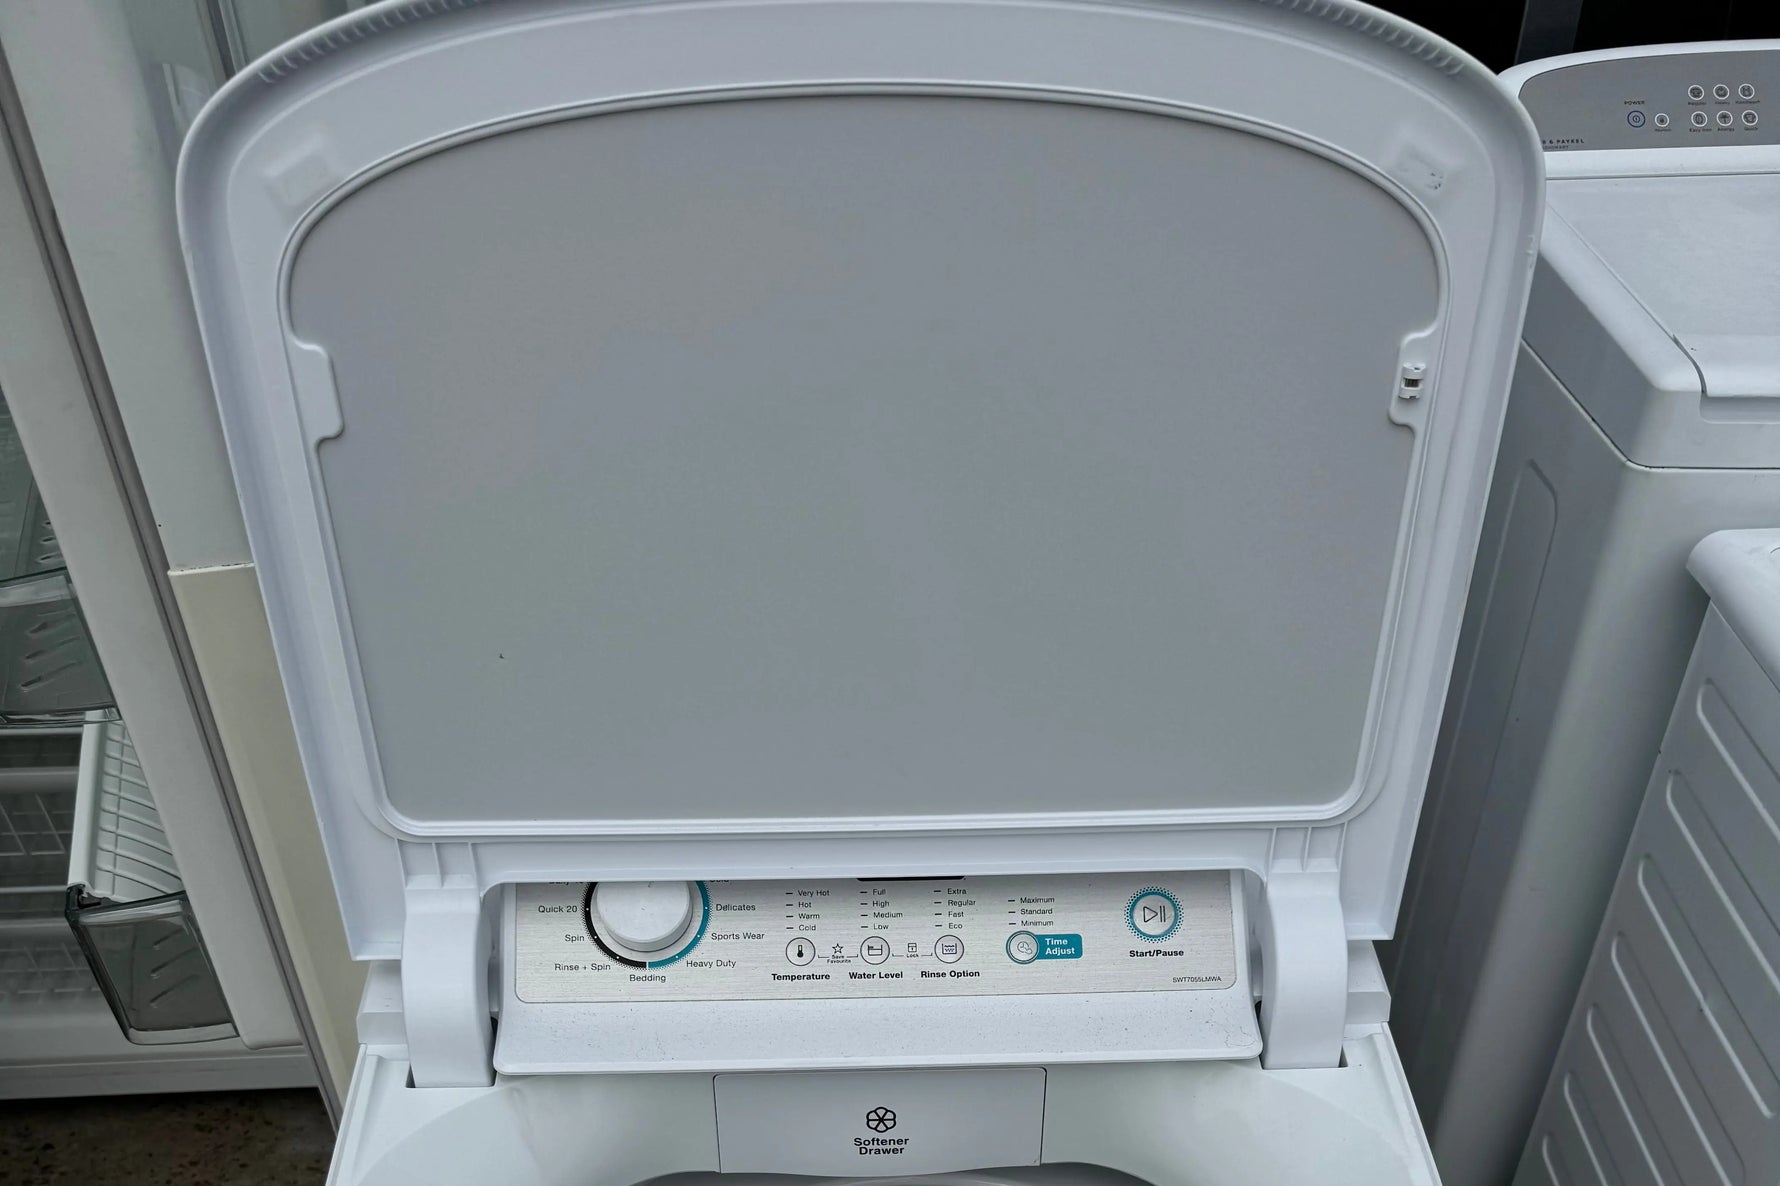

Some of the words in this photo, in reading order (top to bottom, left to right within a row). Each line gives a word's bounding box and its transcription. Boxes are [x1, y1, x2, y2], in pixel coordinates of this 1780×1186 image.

[798, 890, 814, 898] Very
[816, 889, 830, 897] Hot
[872, 900, 890, 908] High
[948, 899, 976, 908] Regular
[1020, 896, 1055, 904] Maximum
[538, 905, 564, 914] Quick
[566, 905, 578, 913] 20
[716, 903, 756, 911] Delicates
[873, 911, 903, 919] Medium
[1020, 908, 1053, 916] Standard
[1021, 919, 1054, 927] Minimum
[564, 934, 584, 944] Spin
[712, 932, 740, 942] Sports
[743, 932, 765, 940] Wear
[1045, 938, 1068, 946] Time
[1045, 946, 1075, 956] Adjust
[1129, 949, 1184, 958] Start/Pause
[554, 963, 580, 972] Rinse
[590, 963, 610, 972] Spin
[686, 960, 714, 970] Heavy
[717, 960, 737, 969] Duty
[630, 974, 666, 983] Bedding
[772, 973, 830, 982] Temperature
[849, 972, 876, 980] Water
[879, 970, 904, 979] Level
[920, 970, 947, 978] Rinse
[950, 969, 980, 979] Option
[854, 1137, 910, 1146] Softener
[859, 1146, 904, 1155] Drawer
